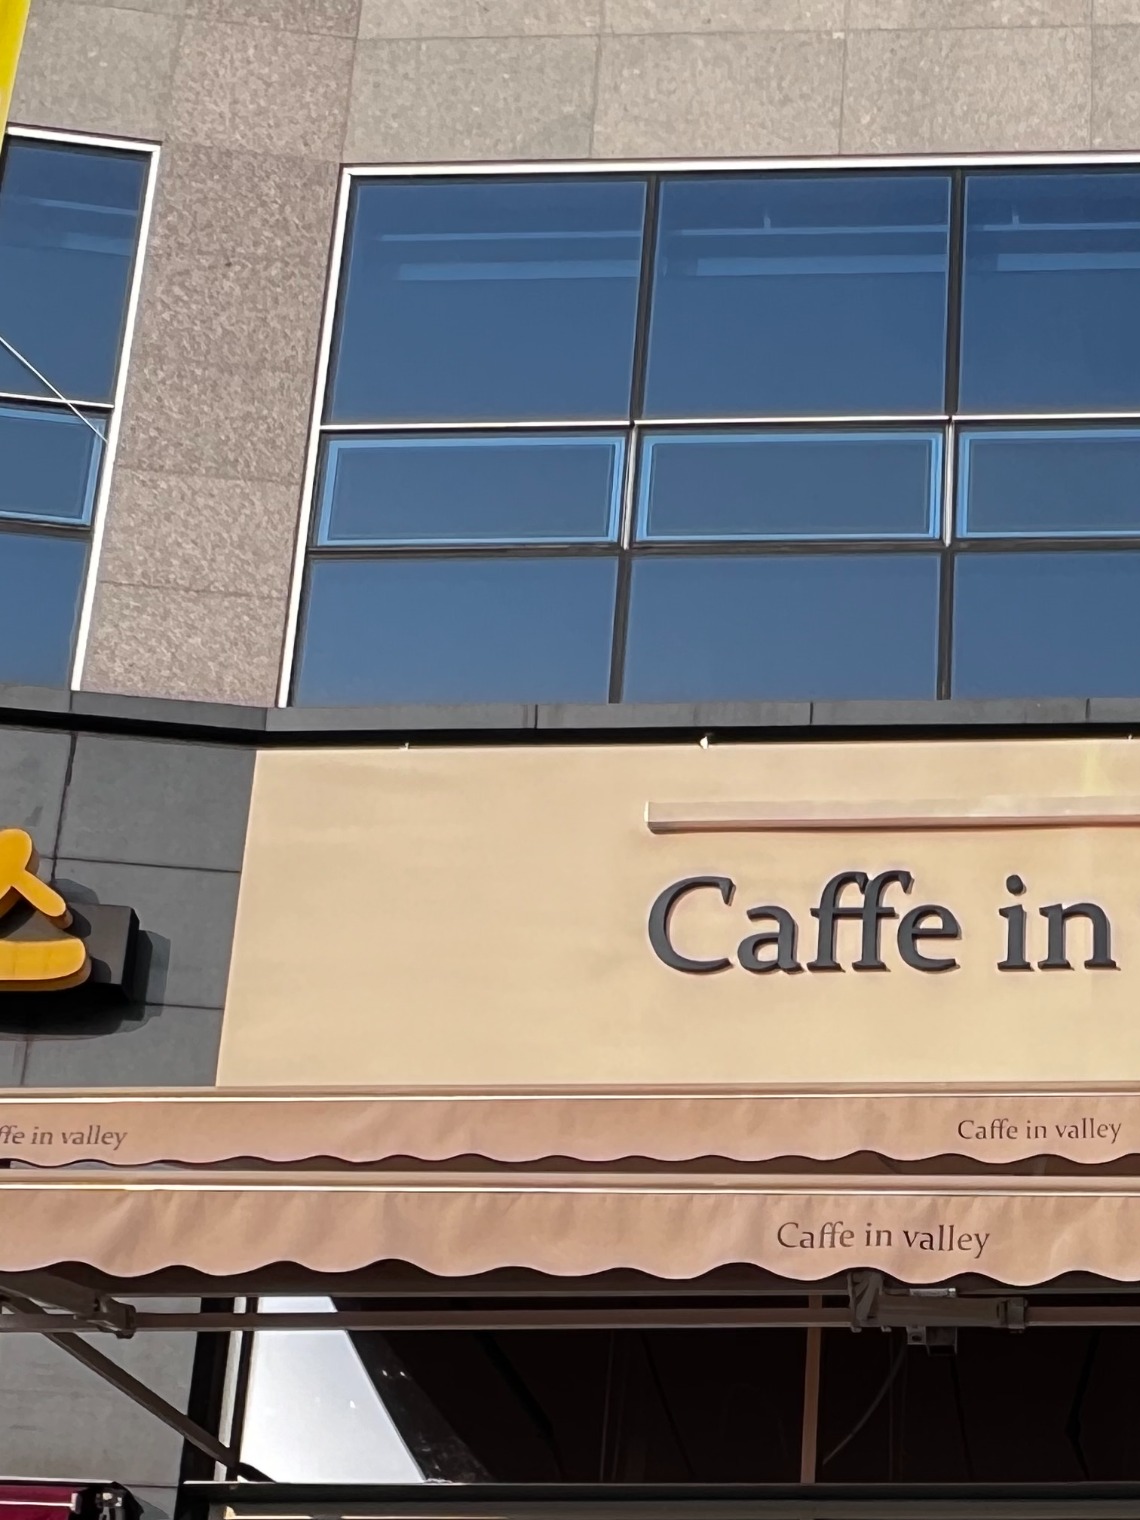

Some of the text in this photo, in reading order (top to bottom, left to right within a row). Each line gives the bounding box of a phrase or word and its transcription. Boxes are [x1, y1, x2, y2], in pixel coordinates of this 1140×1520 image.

[647, 869, 962, 973] Caffe
[997, 874, 1119, 971] in
[30, 1125, 54, 1145] in
[61, 1124, 128, 1151] valley
[957, 1117, 1122, 1145] Caffe in valley
[776, 1220, 991, 1259] Caffe in valley
